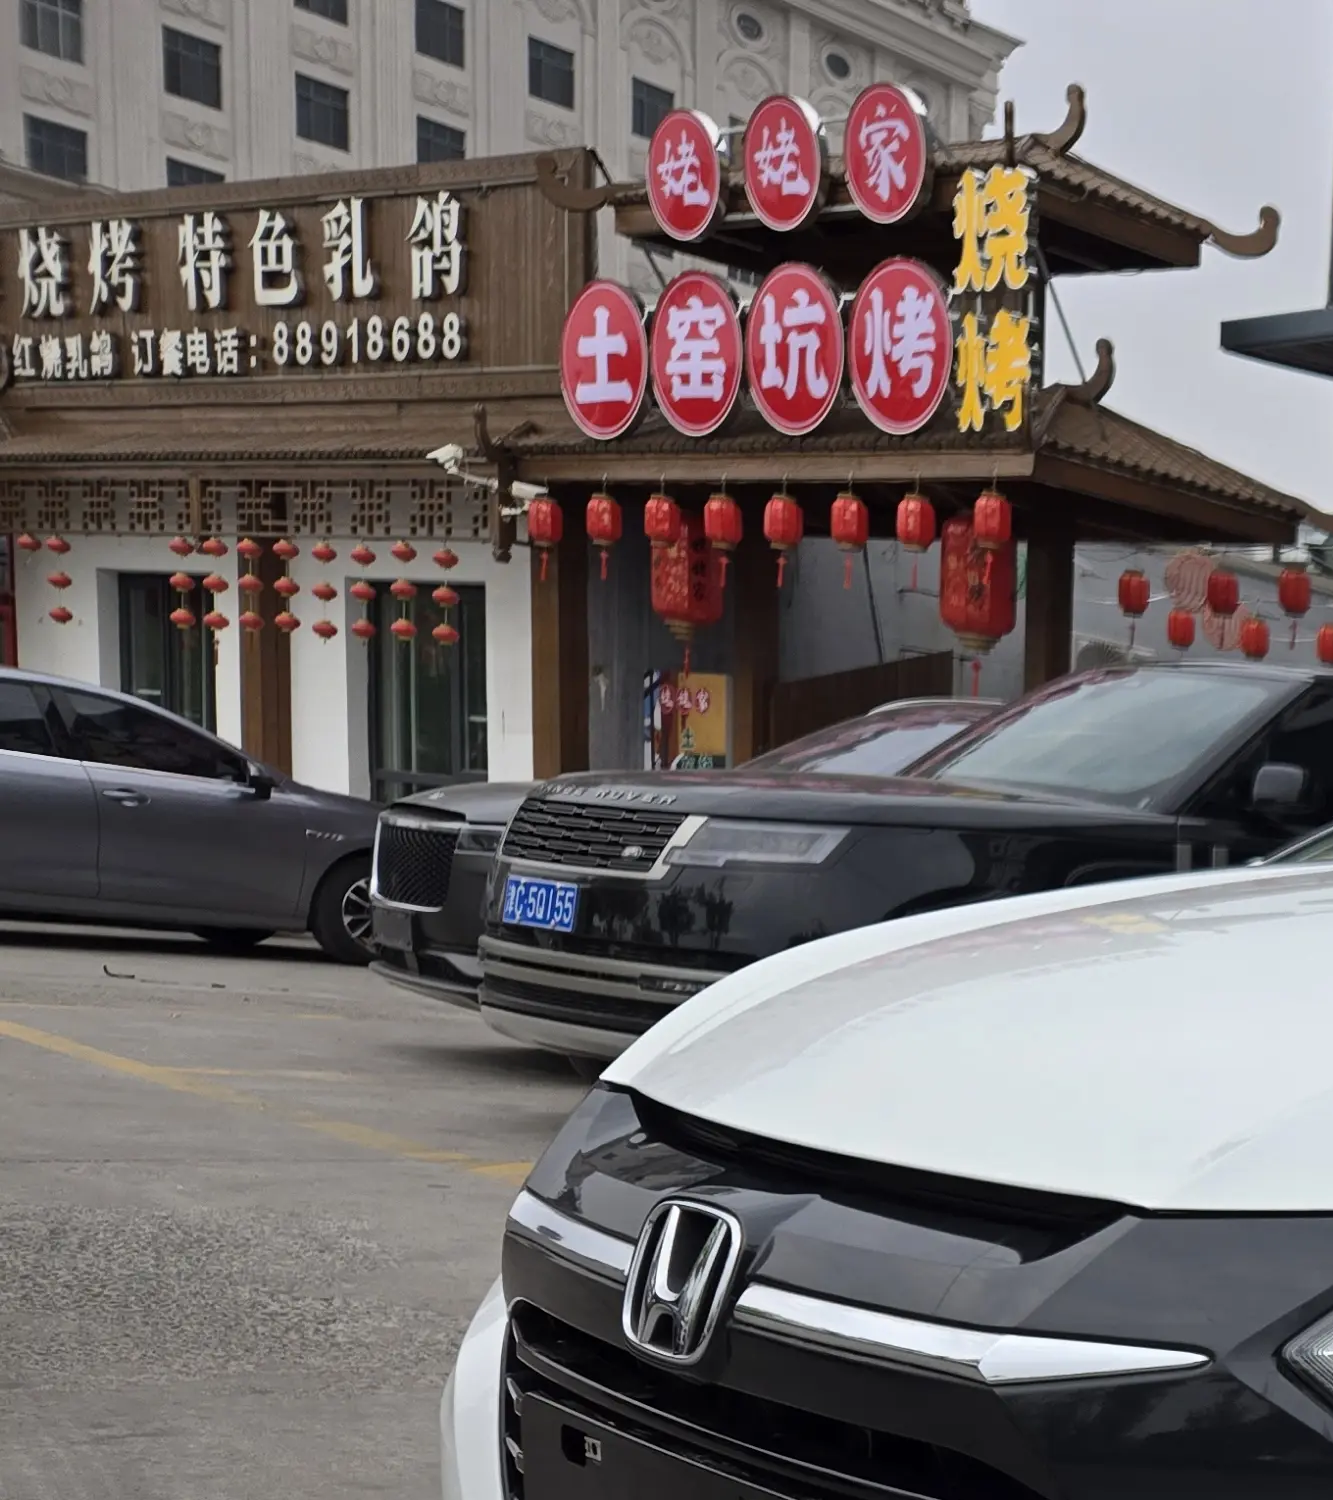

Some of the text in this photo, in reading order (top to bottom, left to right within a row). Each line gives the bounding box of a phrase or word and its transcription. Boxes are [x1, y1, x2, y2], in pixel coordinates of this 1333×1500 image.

[656, 102, 912, 207] 姥姥家
[17, 190, 463, 319] 烧烤 特色乳鸽
[953, 165, 1031, 433] 烧烤
[12, 329, 113, 380] 红烧乳鸽
[575, 287, 936, 403] 土窑坑烤
